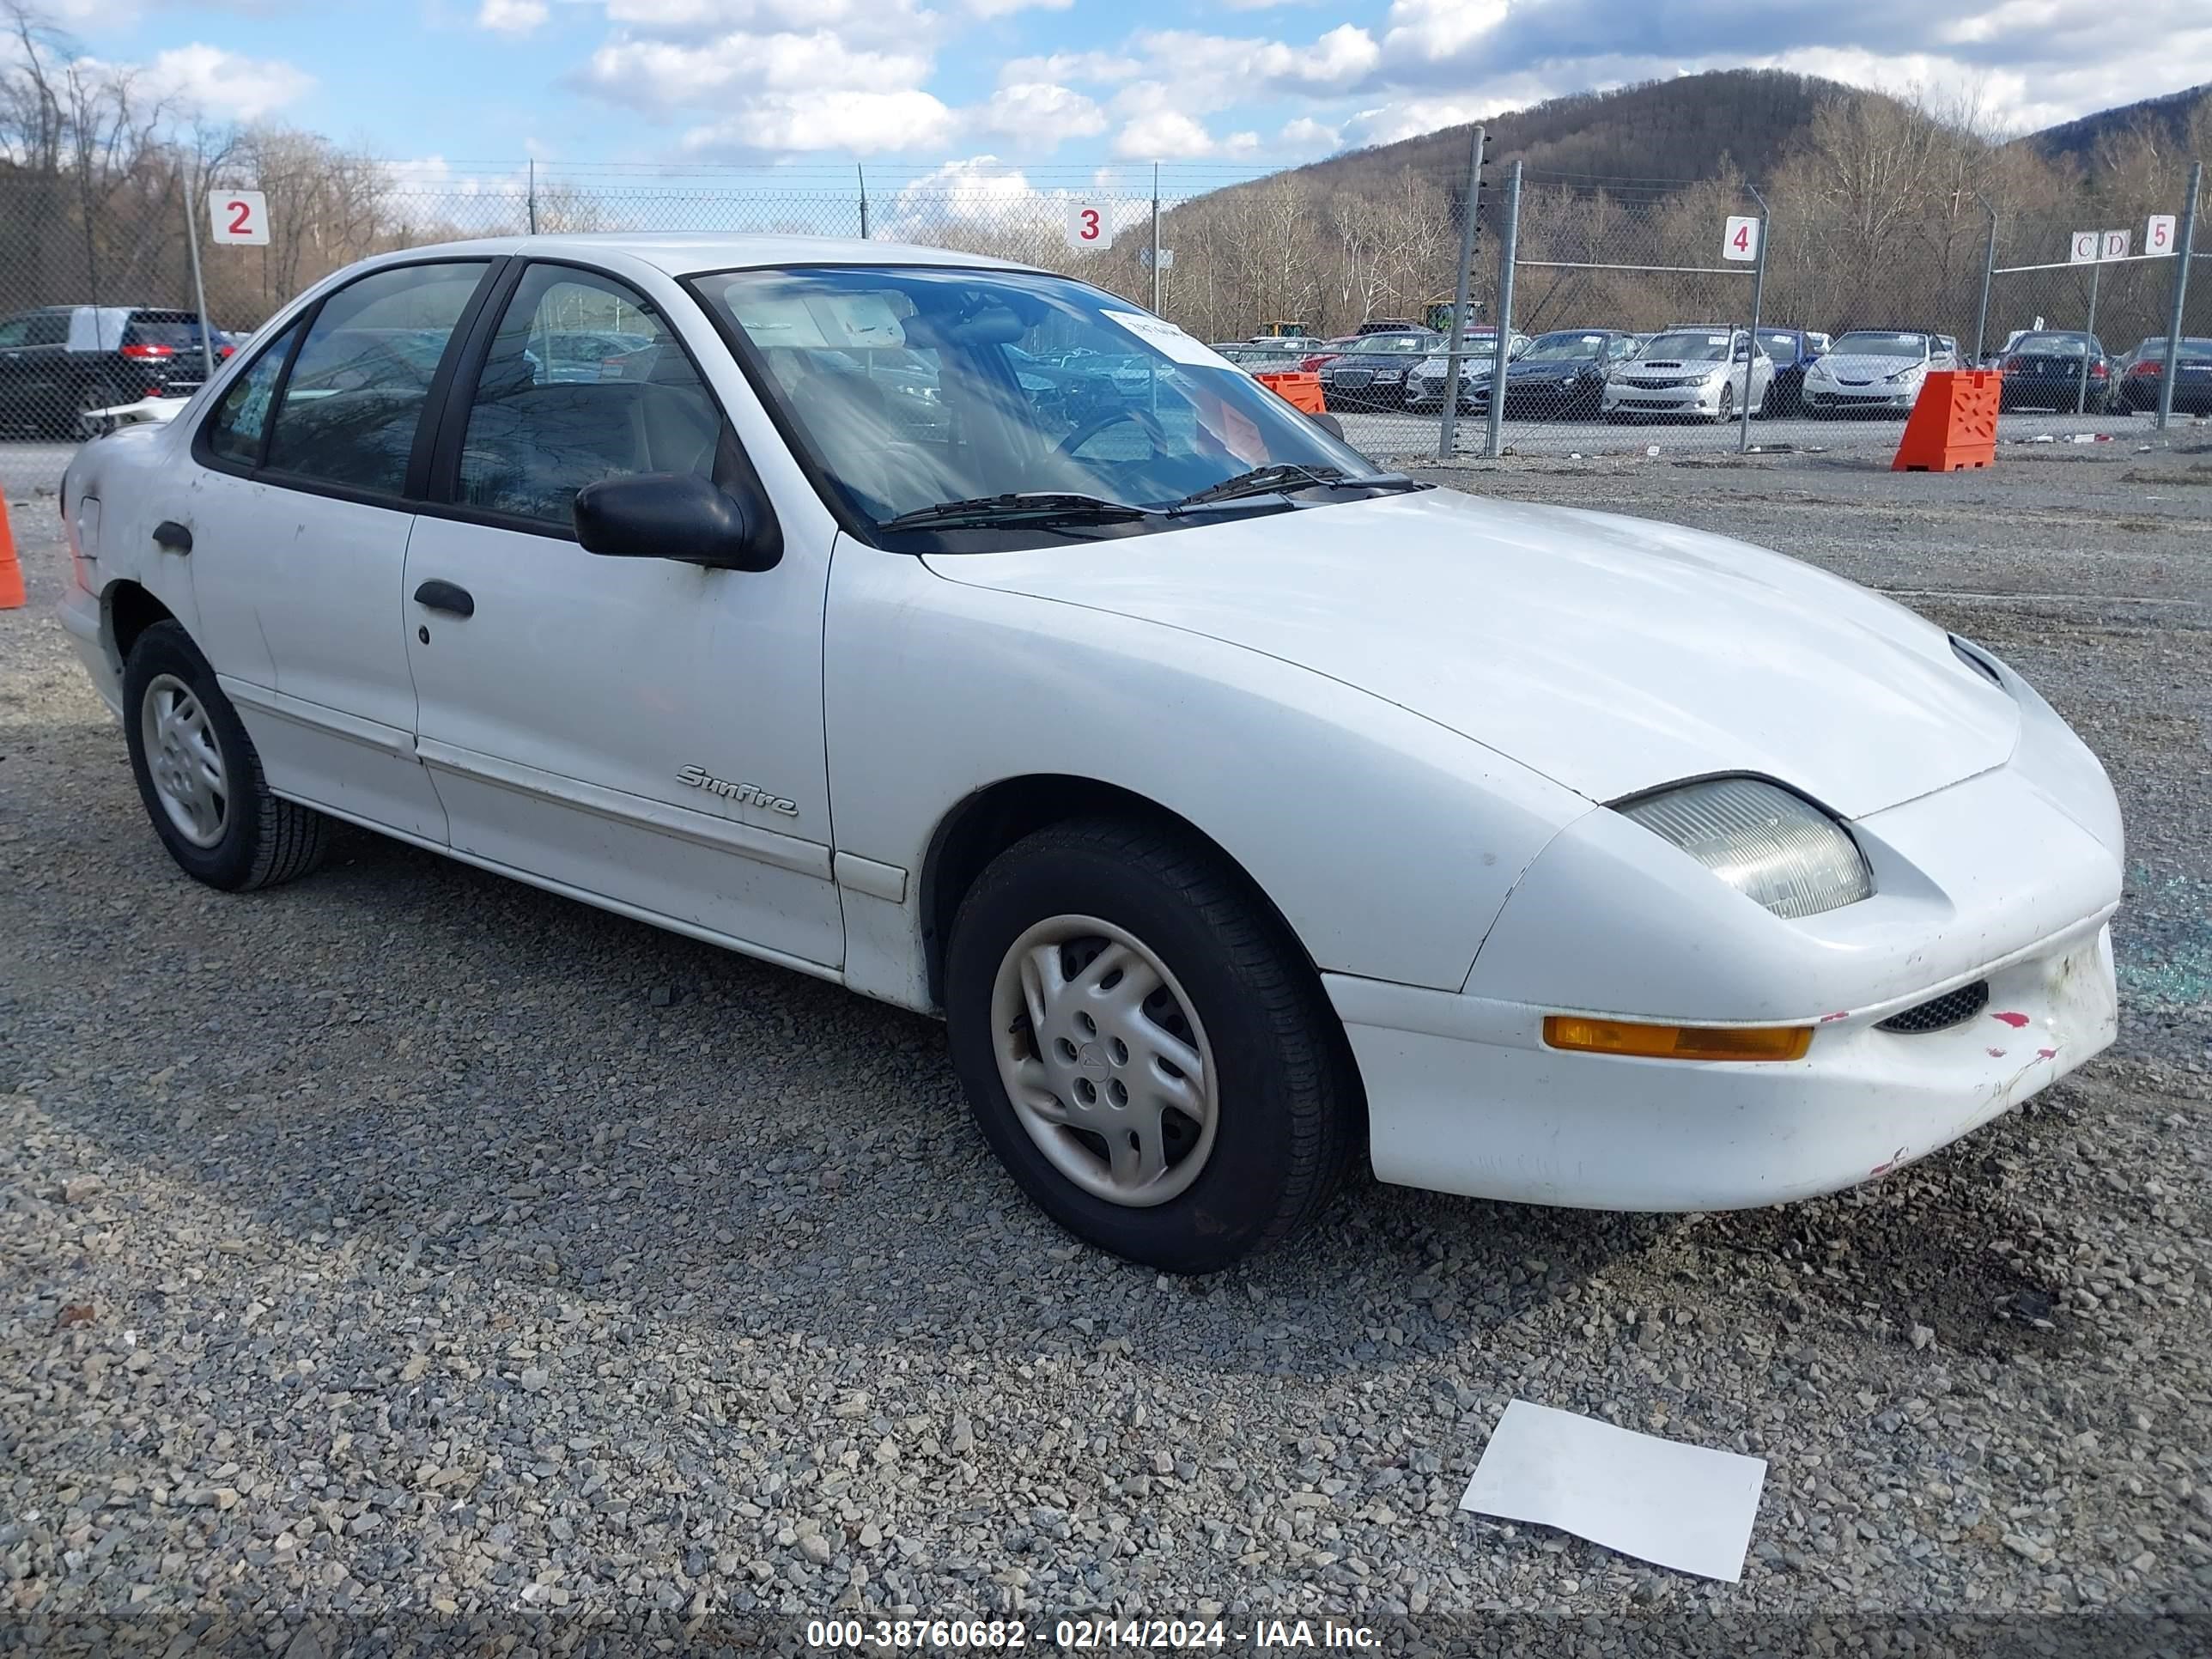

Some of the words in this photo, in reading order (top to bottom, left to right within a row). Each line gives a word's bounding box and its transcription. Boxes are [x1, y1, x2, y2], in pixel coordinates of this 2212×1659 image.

[227, 201, 252, 234] 2
[1080, 209, 1100, 240] 3
[1733, 226, 1748, 251] 4
[2077, 236, 2092, 257] C
[2108, 235, 2124, 256] D
[2154, 222, 2167, 247] 5
[675, 763, 799, 817] Sunfire
